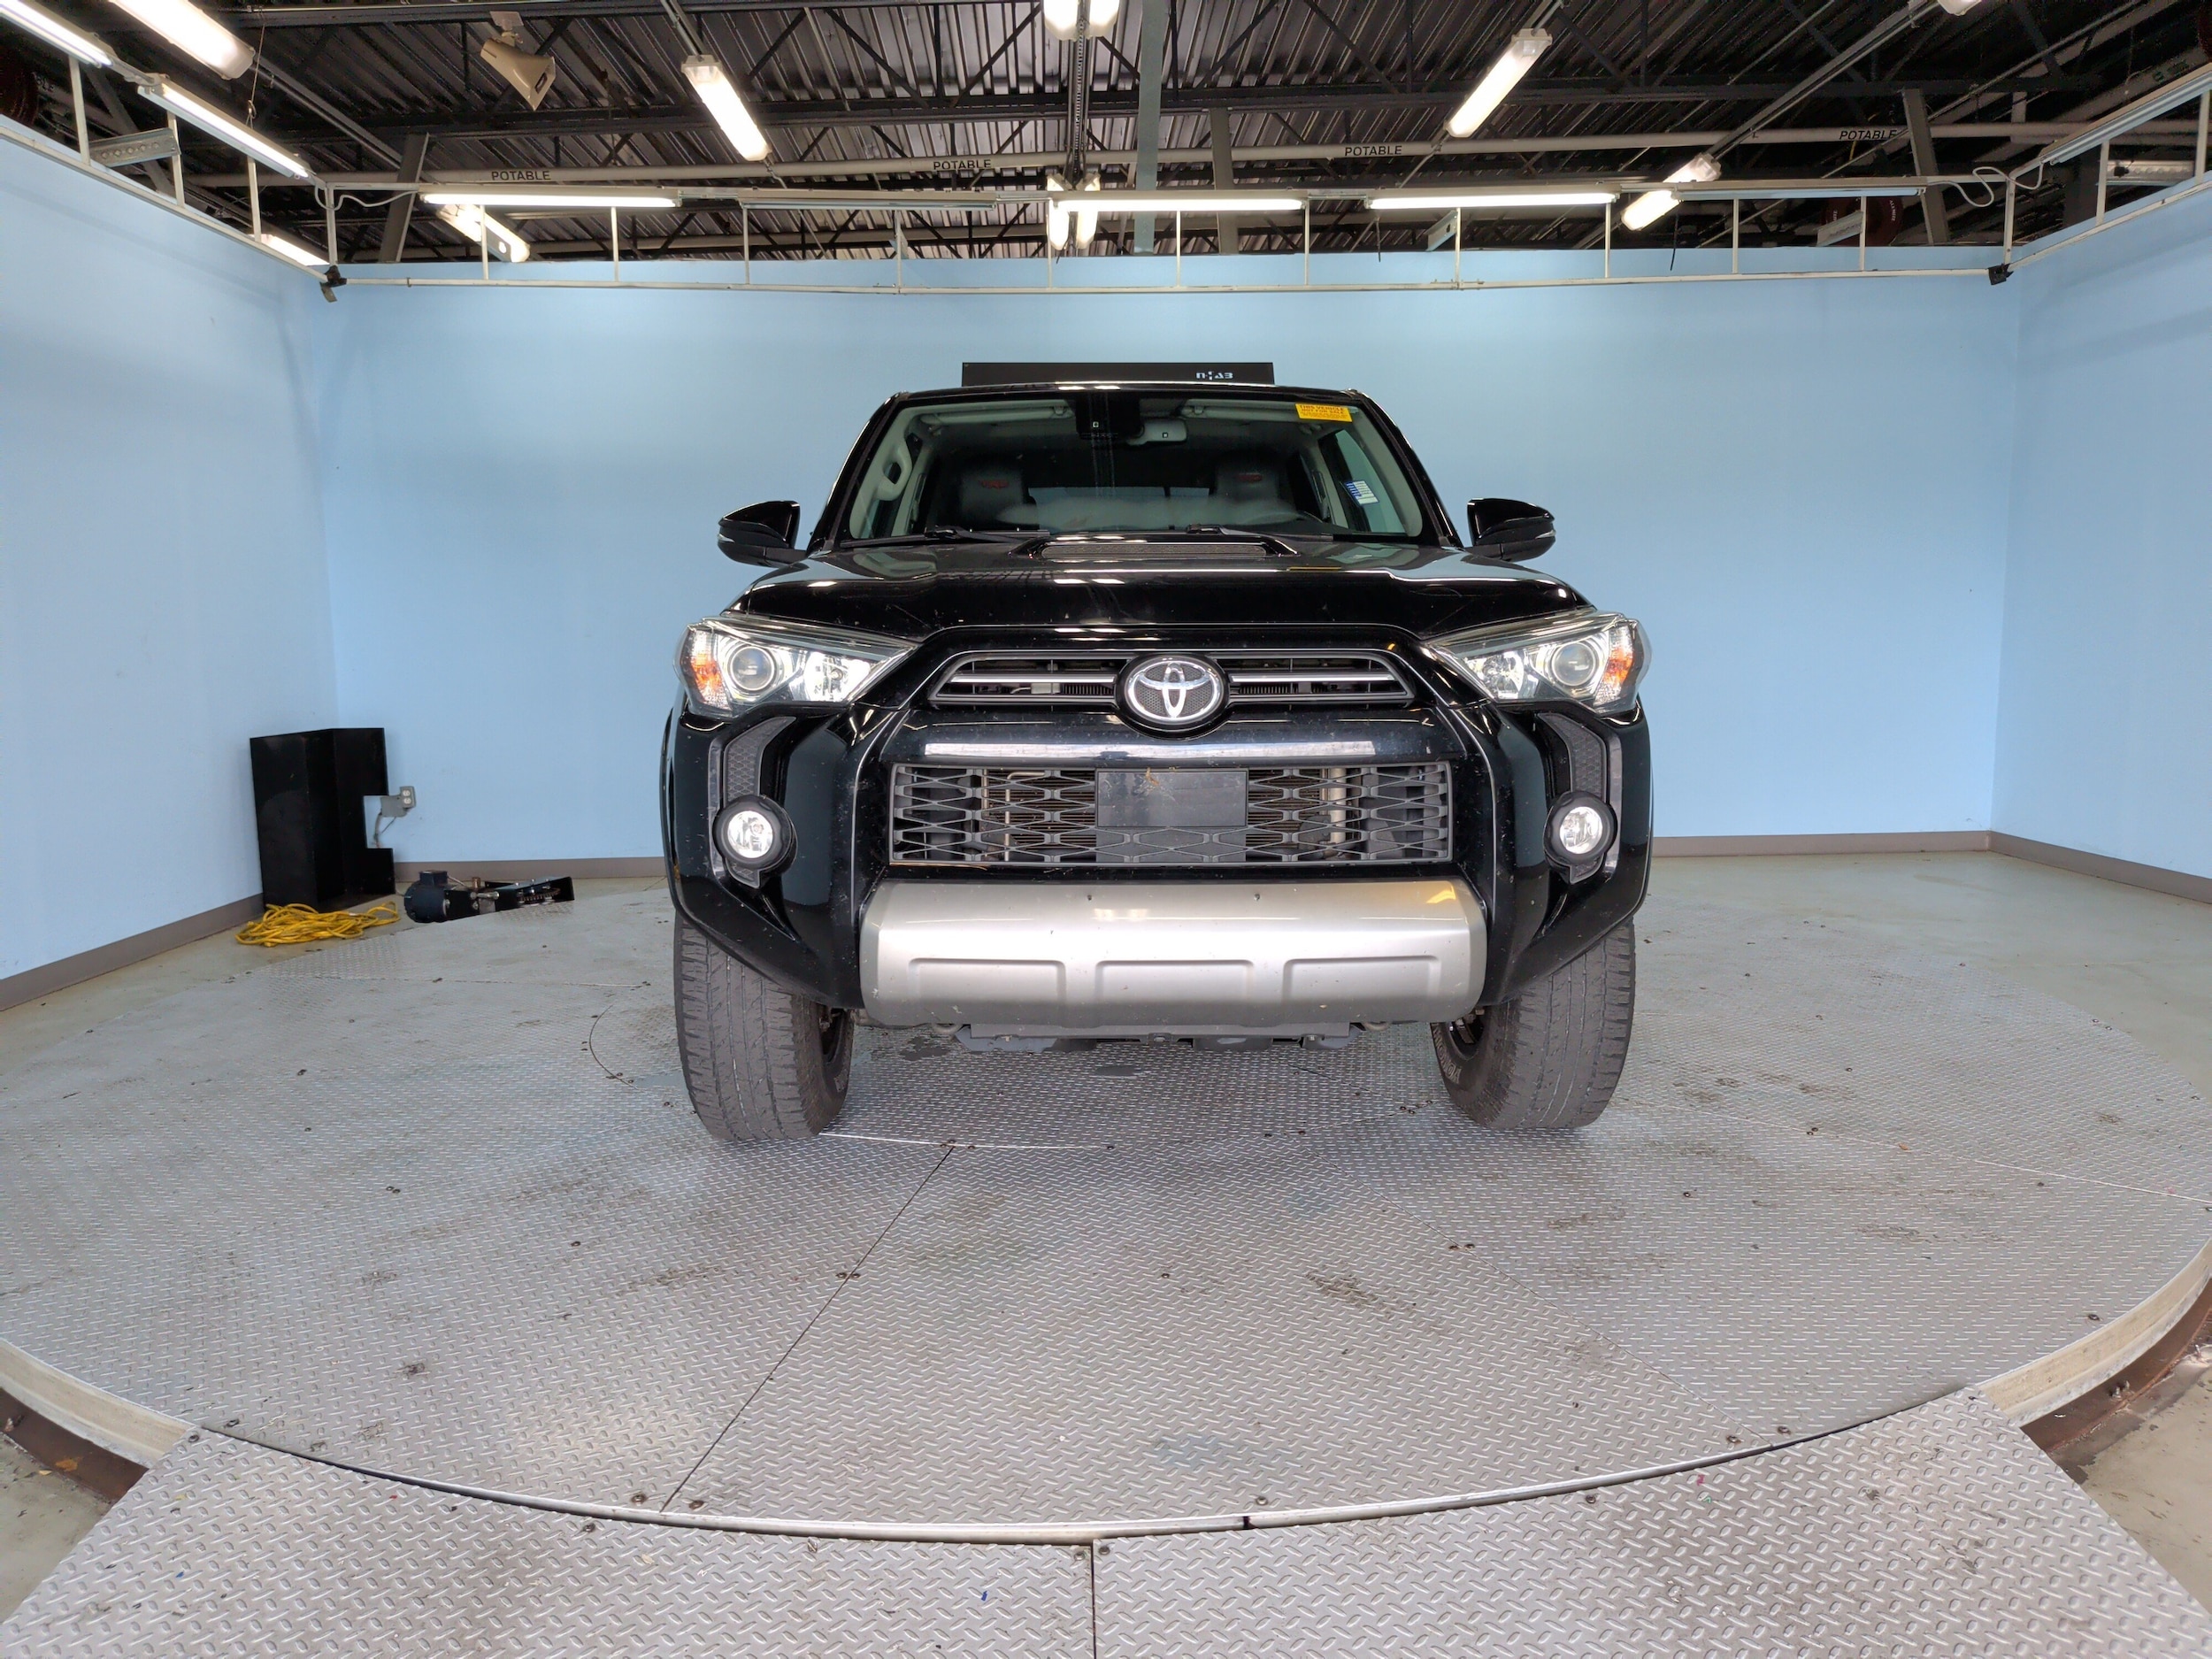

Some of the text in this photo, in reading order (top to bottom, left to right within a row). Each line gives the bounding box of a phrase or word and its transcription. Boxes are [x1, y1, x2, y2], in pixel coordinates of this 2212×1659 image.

[1839, 129, 1897, 140] POTABLE
[1345, 145, 1402, 156] POTABLE
[933, 159, 992, 170] POTABLE
[490, 170, 551, 180] POTABLE
